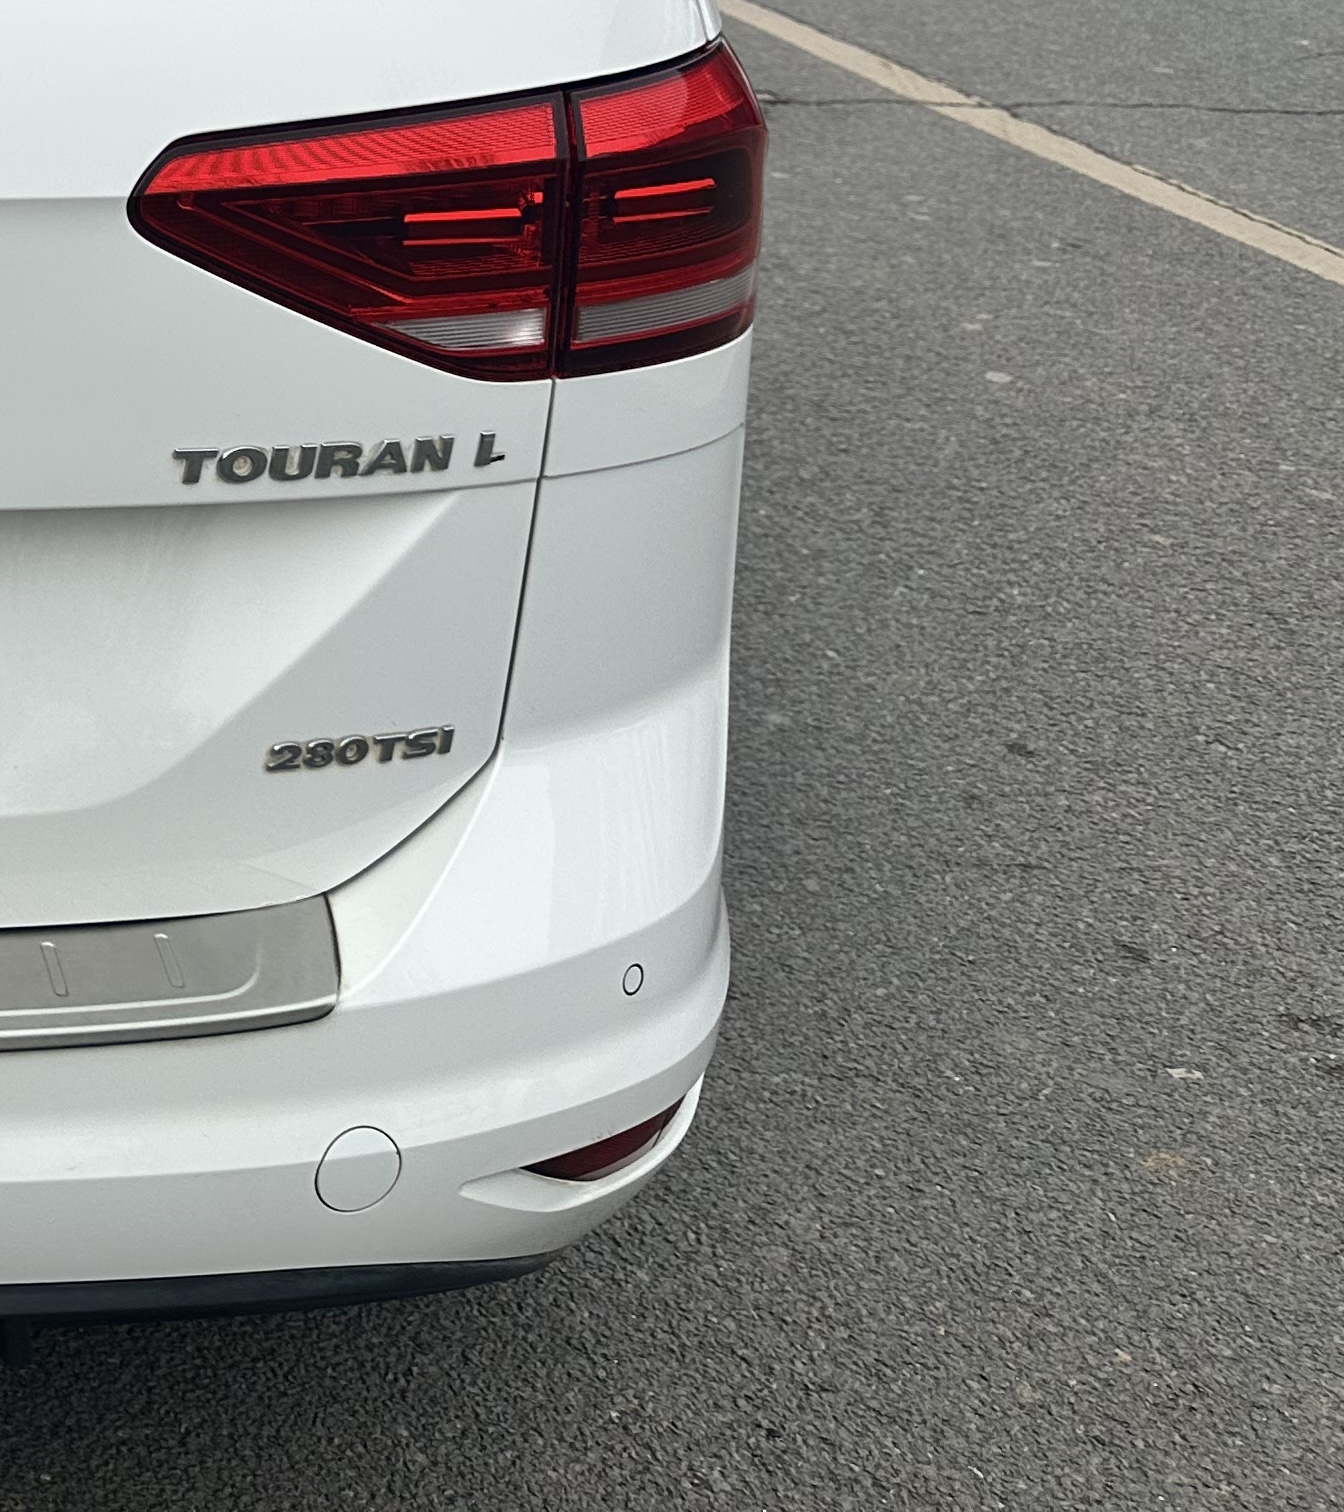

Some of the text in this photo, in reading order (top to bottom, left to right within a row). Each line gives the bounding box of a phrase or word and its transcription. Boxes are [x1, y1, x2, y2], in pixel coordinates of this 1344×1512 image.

[172, 430, 506, 485] TOURAN L
[264, 723, 455, 773] 280TSI
